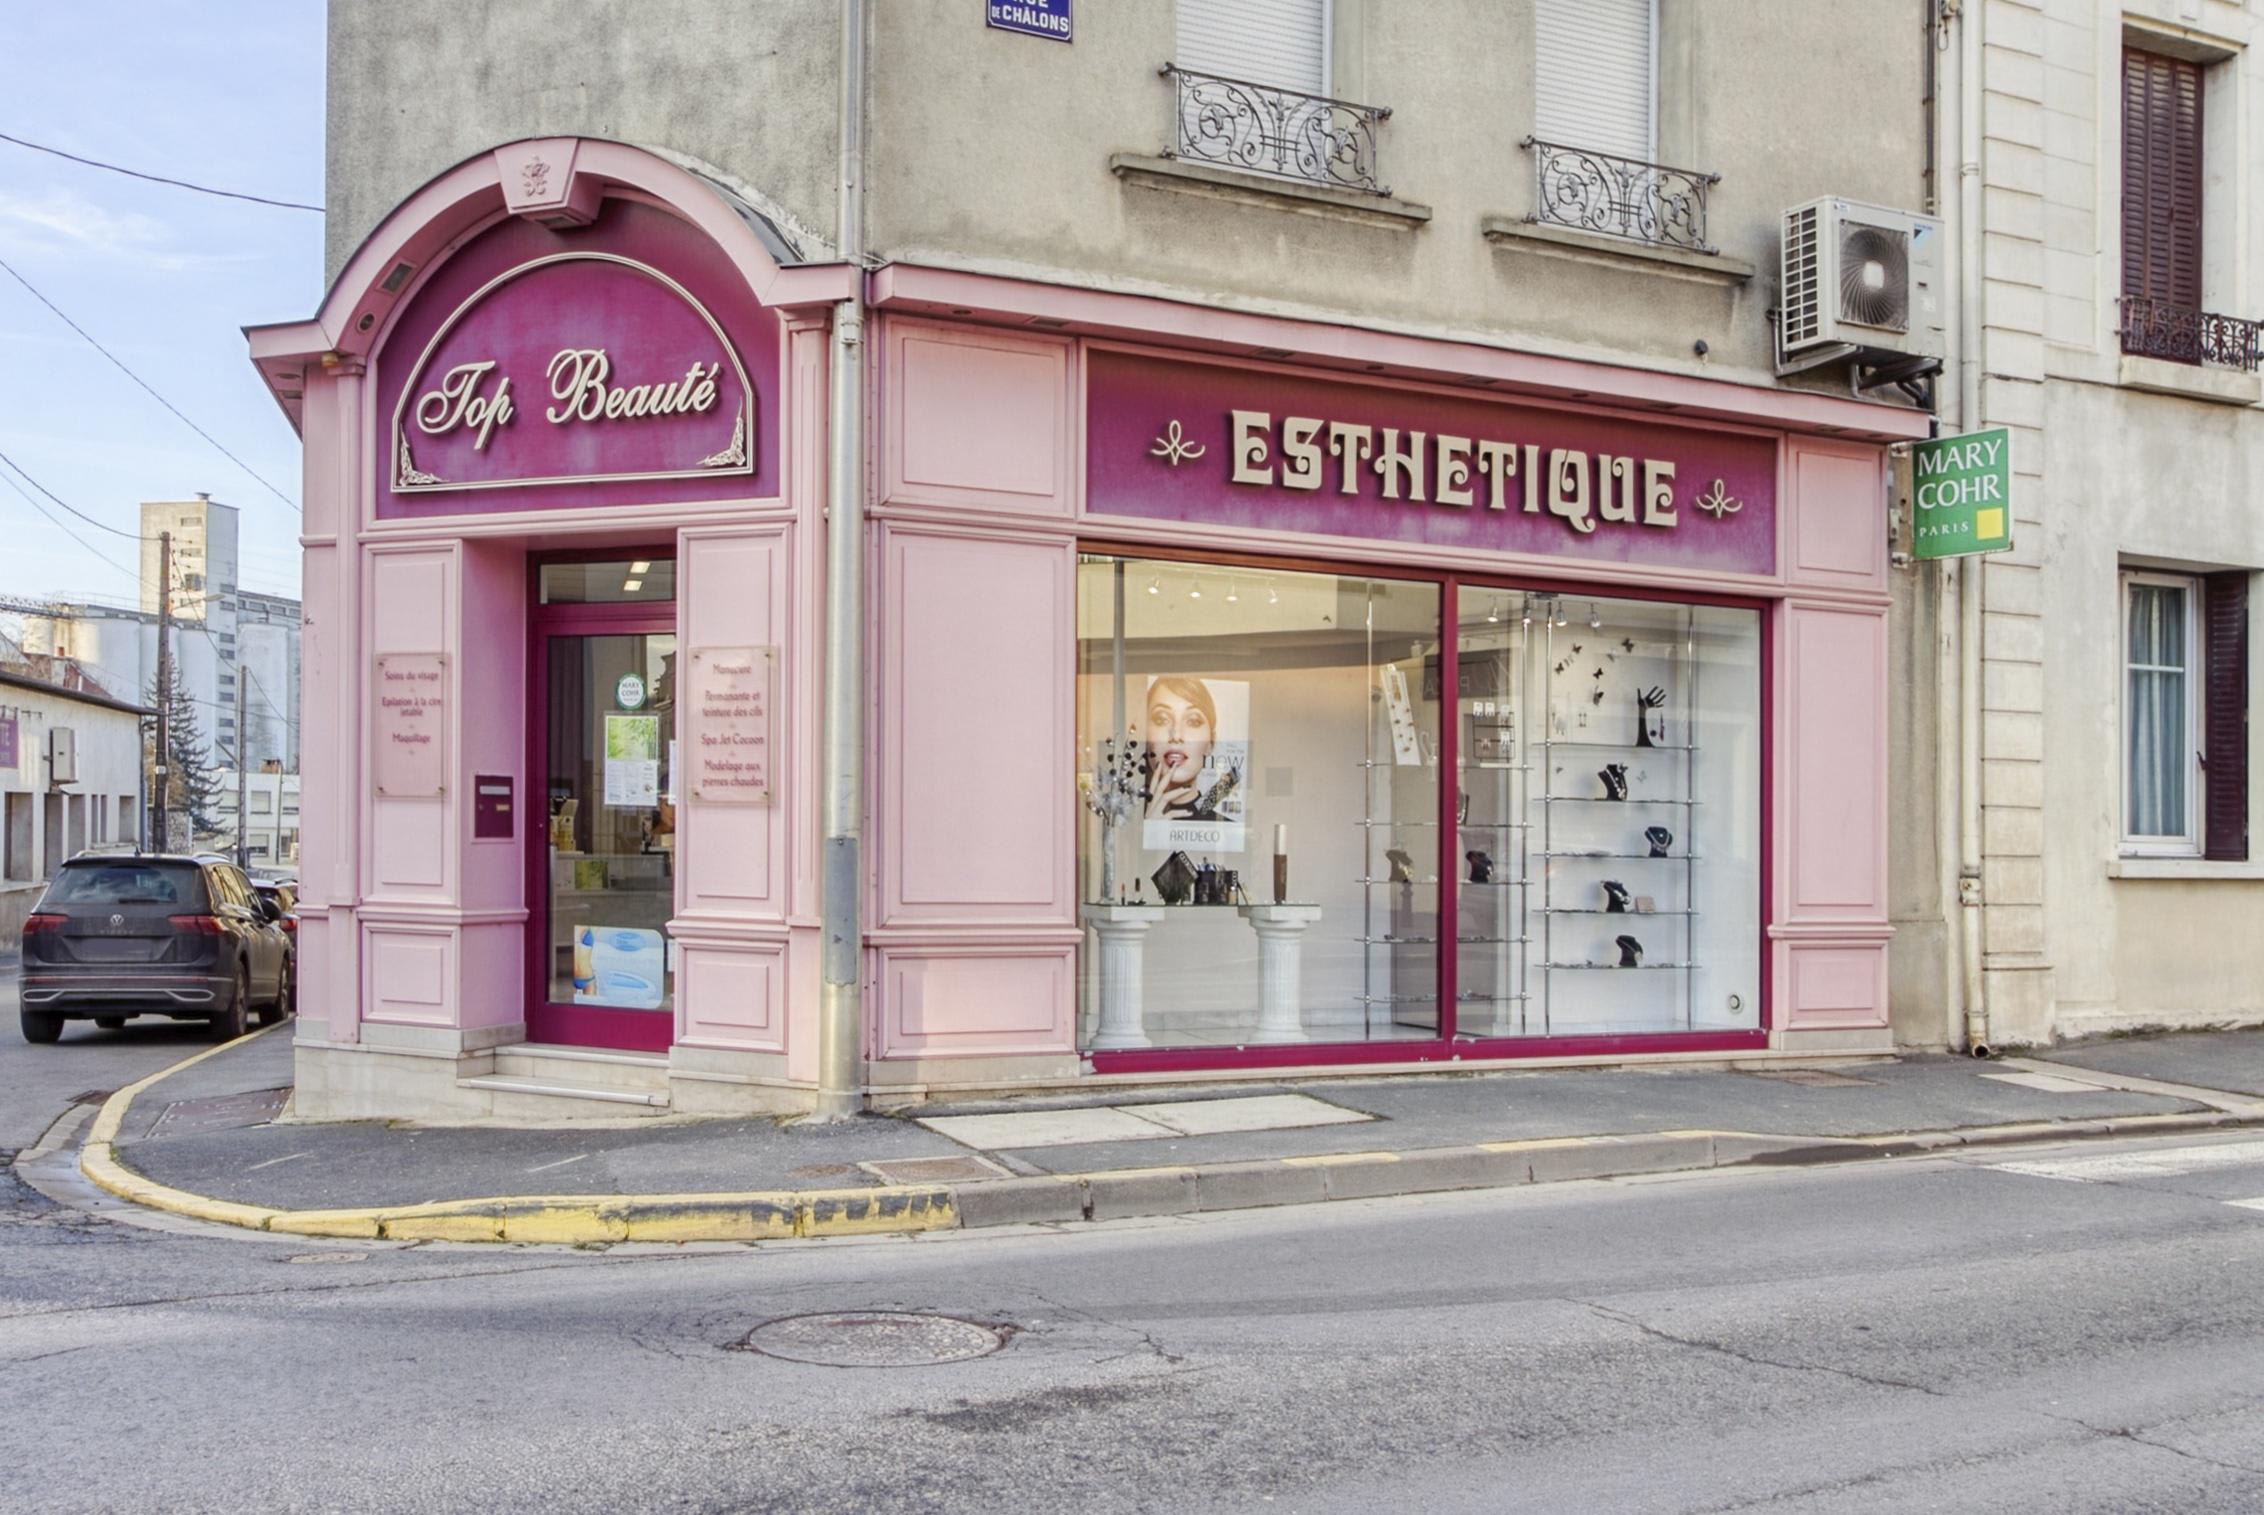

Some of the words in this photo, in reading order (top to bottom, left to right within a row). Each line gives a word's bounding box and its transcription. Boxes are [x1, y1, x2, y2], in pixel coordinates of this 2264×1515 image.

[991, 6, 1000, 19] DE
[416, 360, 514, 450] Top
[546, 349, 720, 424] Beauté
[1918, 438, 2002, 477] MARY
[1231, 409, 1677, 533] ESTHETIQUE
[1918, 474, 2002, 509] COHR
[1919, 521, 1969, 537] PARIS
[407, 671, 415, 680] du
[418, 670, 438, 681] visage
[701, 733, 717, 746] Spa
[745, 762, 761, 771] aux
[1169, 829, 1220, 843] ARTDECO
